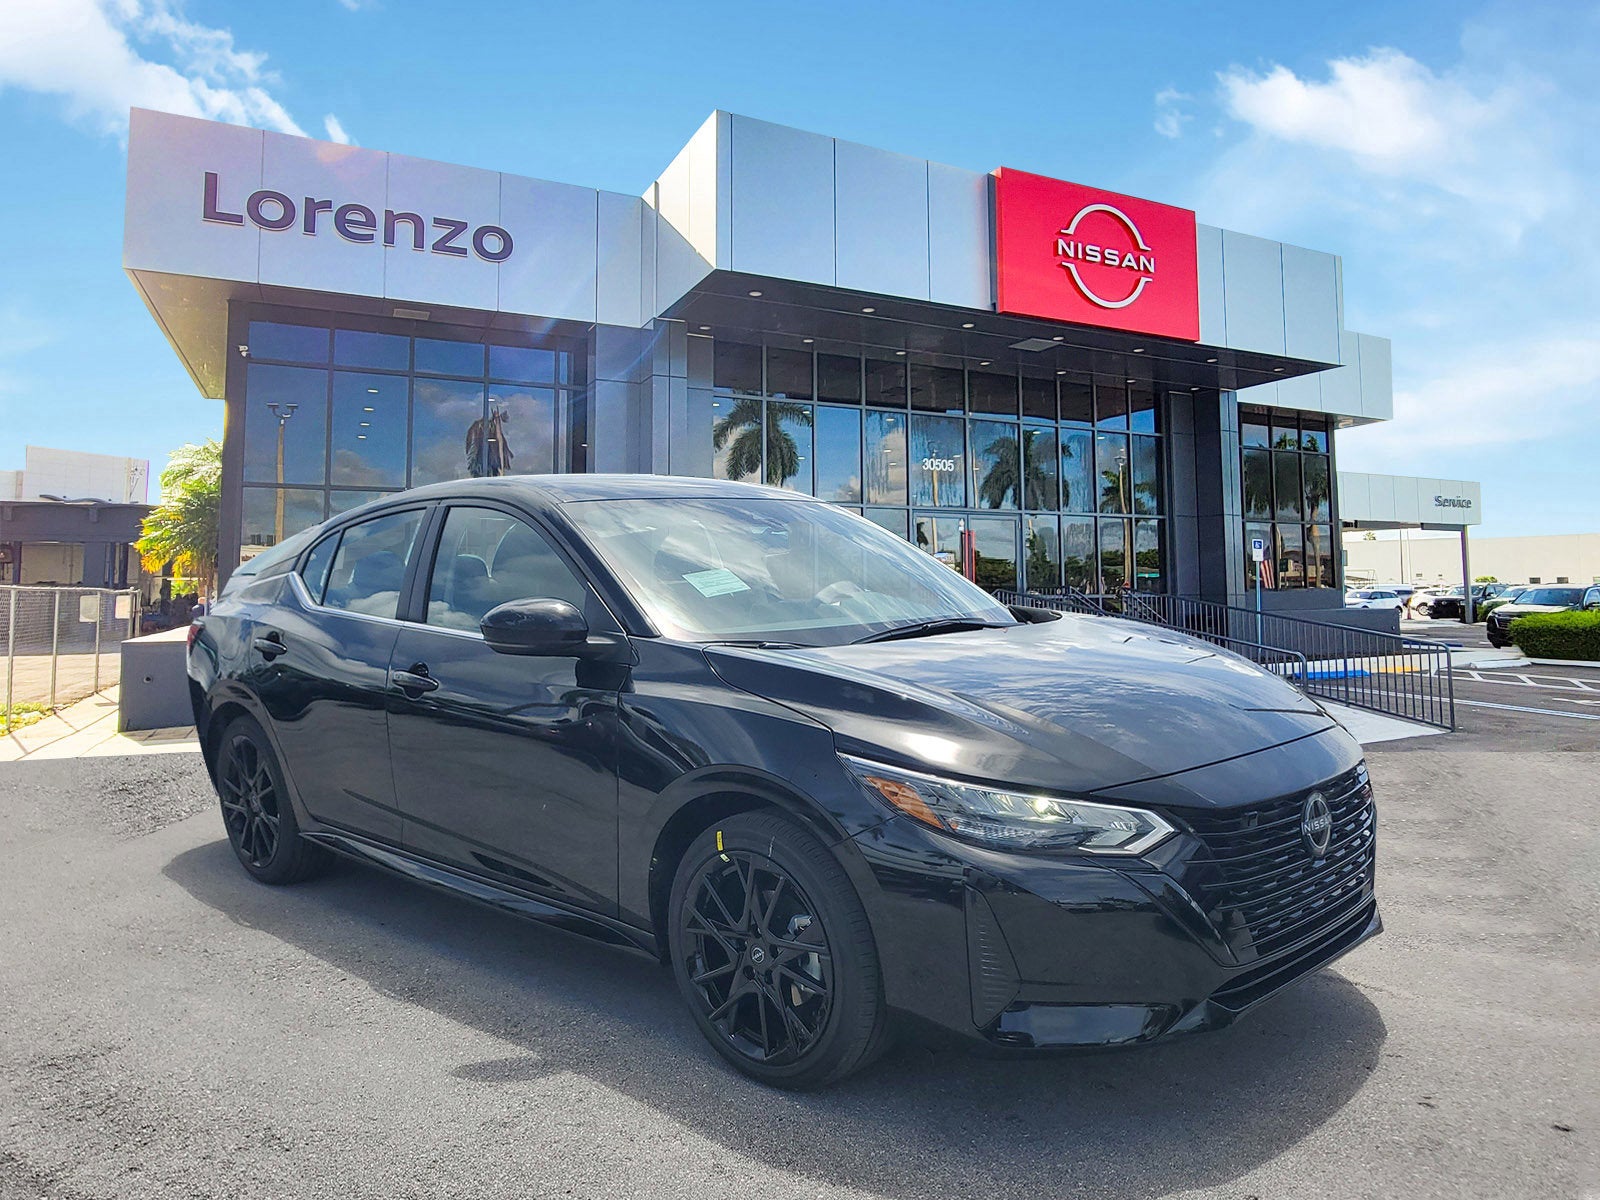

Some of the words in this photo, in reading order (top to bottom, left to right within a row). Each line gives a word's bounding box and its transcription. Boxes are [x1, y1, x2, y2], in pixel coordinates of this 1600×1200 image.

[202, 171, 515, 262] Lorenzo
[1057, 238, 1155, 273] NISSAN
[922, 458, 954, 471] 30505
[1434, 495, 1472, 508] Service
